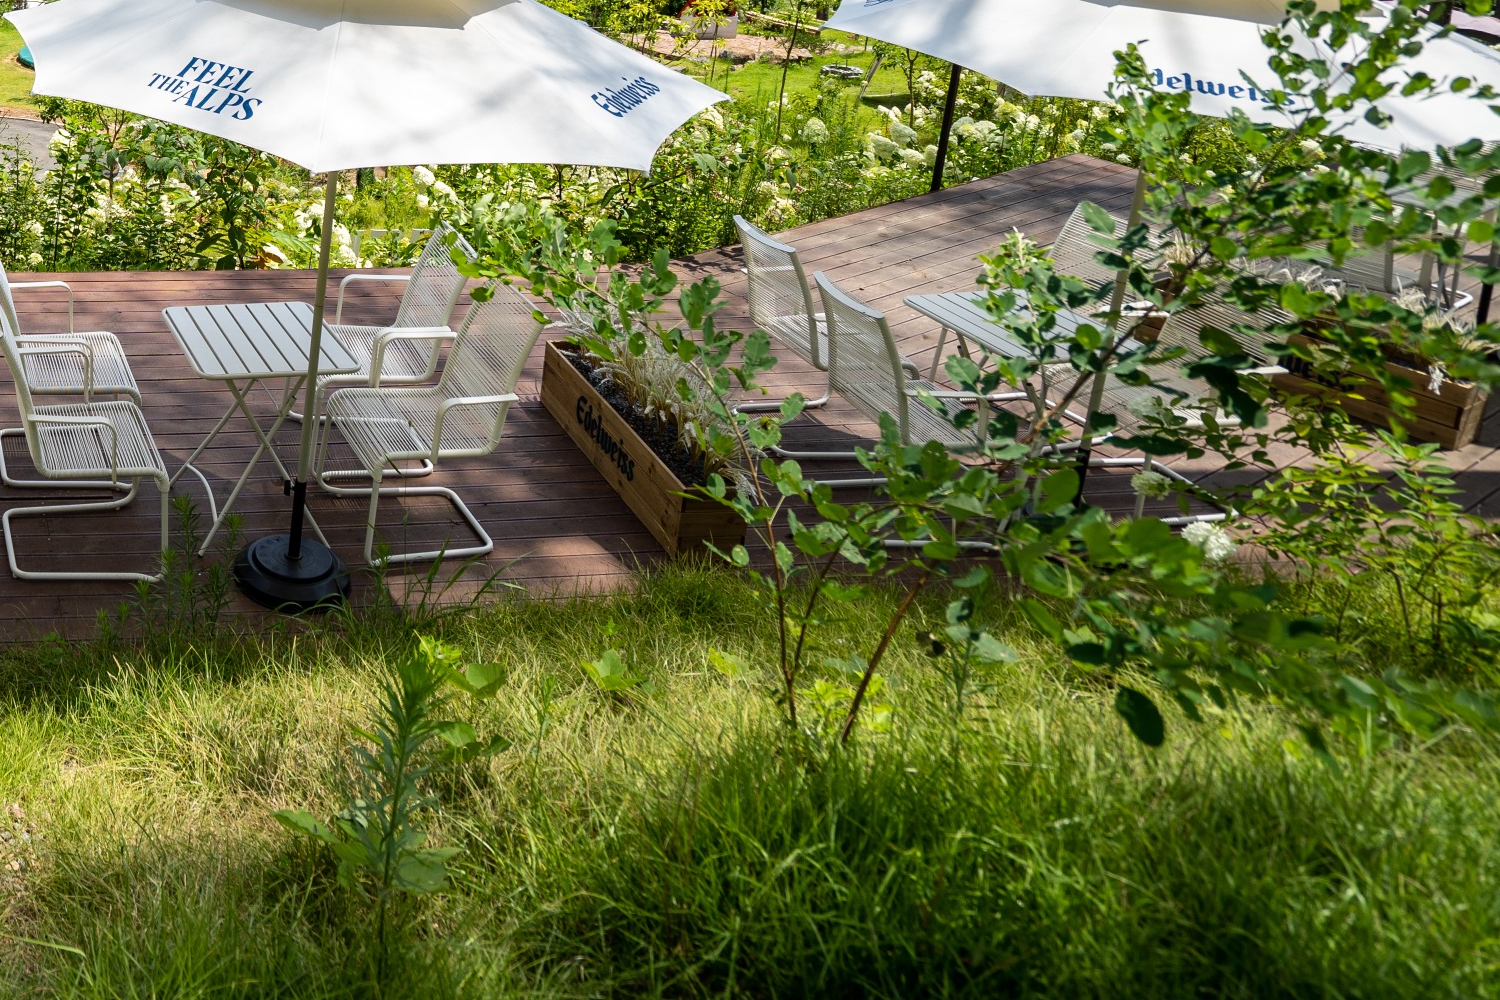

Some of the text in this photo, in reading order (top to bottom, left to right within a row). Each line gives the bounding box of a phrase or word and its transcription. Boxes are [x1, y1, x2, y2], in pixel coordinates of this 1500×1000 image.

[147, 72, 263, 120] THE ALPS
[176, 56, 254, 93] FEEL
[590, 75, 661, 118] Edelweiss
[576, 394, 635, 482] Edelweiss
